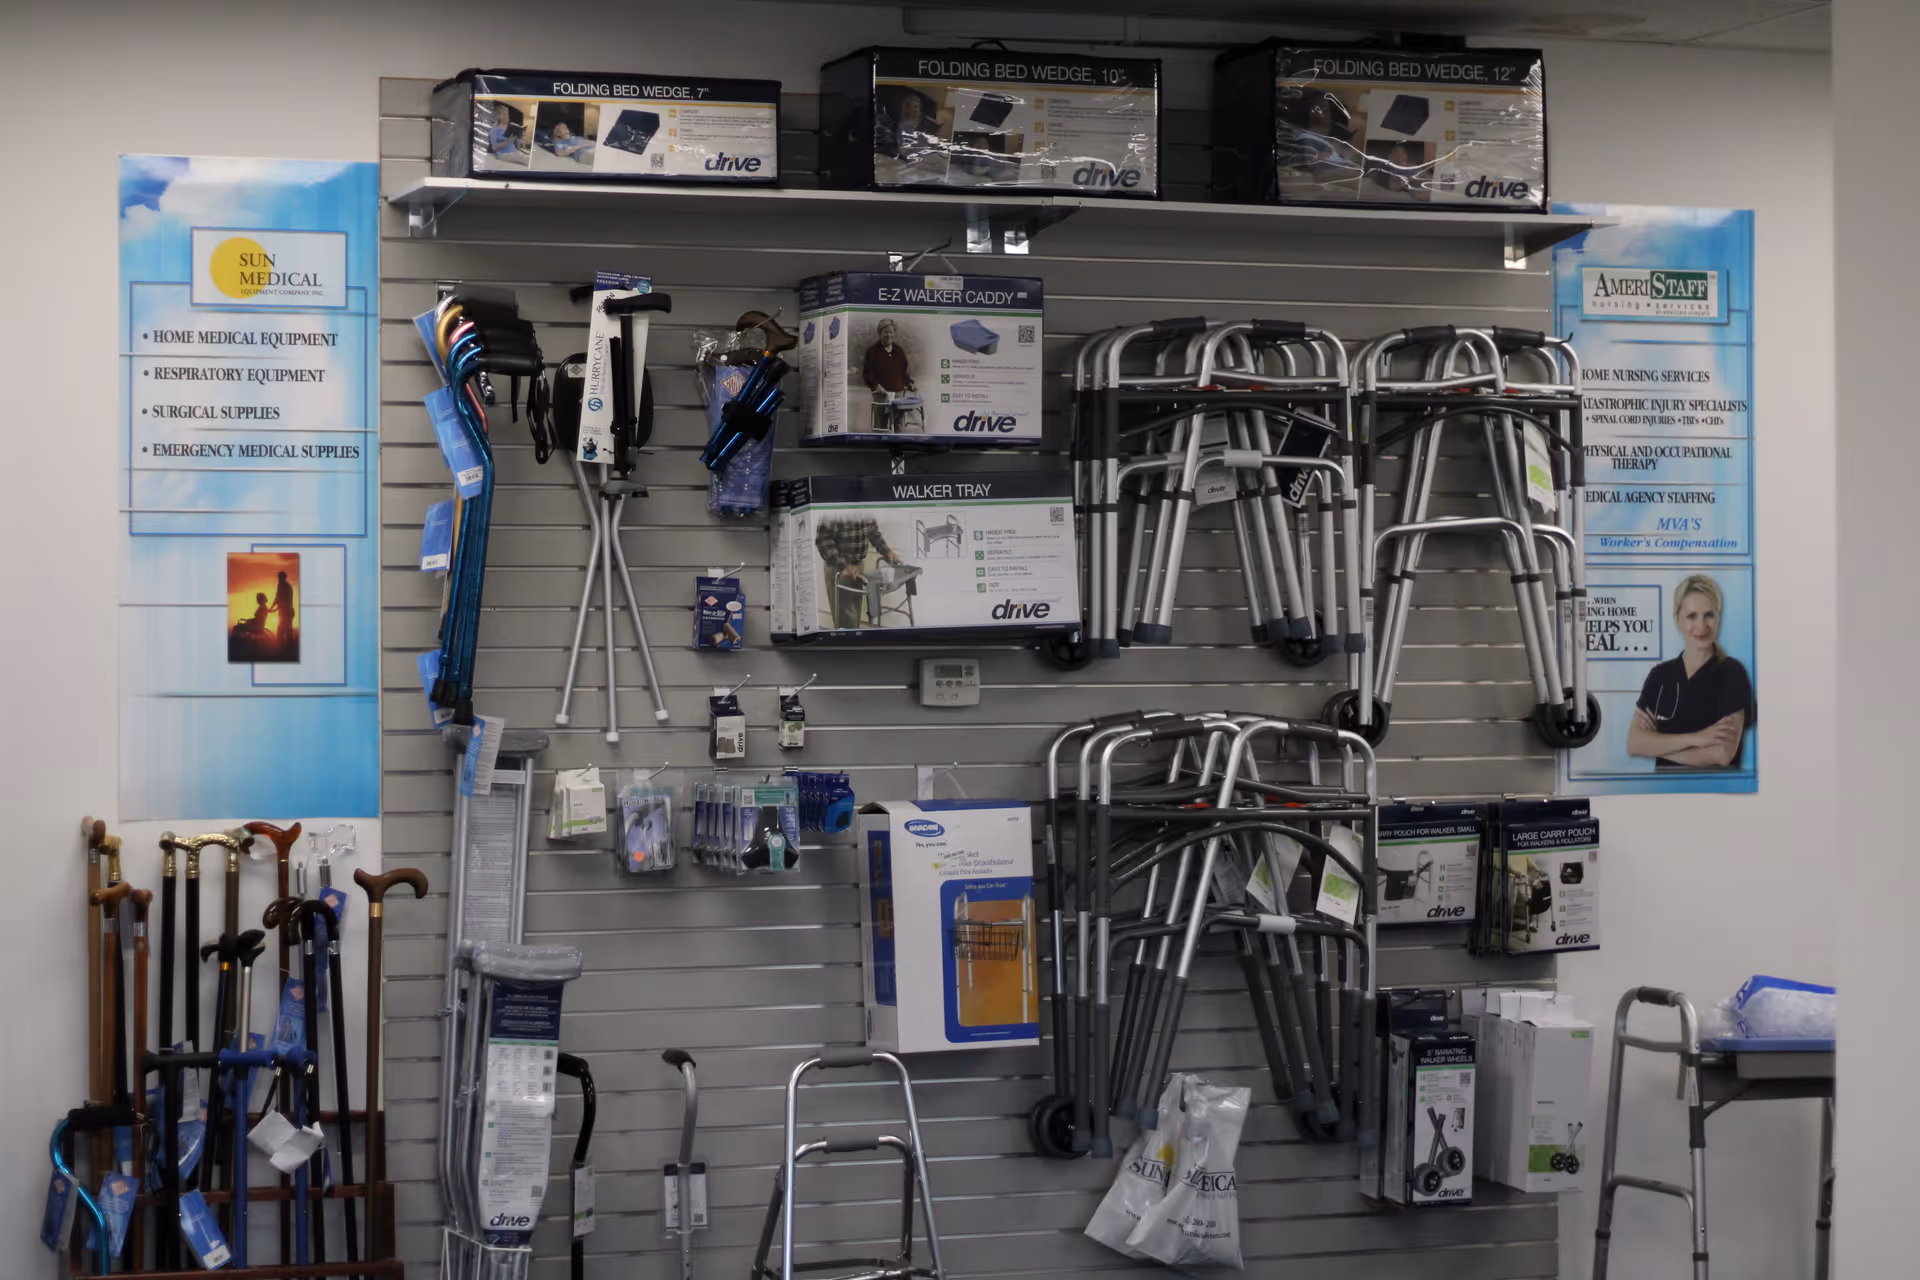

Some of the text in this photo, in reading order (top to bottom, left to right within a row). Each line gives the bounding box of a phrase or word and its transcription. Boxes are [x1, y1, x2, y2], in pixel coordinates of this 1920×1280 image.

[918, 59, 1125, 83] FOLDING BED WEDGE, 10"
[1314, 58, 1516, 82] FOLDING BED WEDGE, 12"
[553, 82, 711, 100] FOLDING BED WEDGE, 7"
[704, 152, 762, 173] drive
[1073, 162, 1142, 189] drive
[1464, 175, 1529, 199] drive
[239, 252, 276, 268] SUN
[240, 271, 323, 287] MEDICAL
[241, 288, 278, 296] EQUIPMENT
[878, 287, 1014, 305] E-Z WALKER CADDY
[1592, 300, 1710, 311] nursing services
[153, 329, 339, 349] HOME MEDICAL EQUIPMENT
[590, 330, 605, 395] HURRYCANE
[153, 367, 326, 385] RESPIRATORY EQUIPMENT
[1612, 369, 1659, 382] NURSING
[1660, 370, 1711, 383] SERVICES
[152, 405, 281, 420] SURGICAL SUPPLIES
[1650, 399, 1686, 413] INJURY
[1688, 400, 1748, 412] SPECIALISTS
[953, 410, 1017, 433] drive
[1591, 414, 1619, 424] SPINAL
[1619, 415, 1642, 424] CORD
[1642, 415, 1676, 427] INJURIES
[153, 443, 360, 460] EMERGENCY MEDICAL SUPPLIES
[1630, 446, 1653, 458] AND
[1654, 446, 1733, 459] OCCUPATIONAL
[1611, 457, 1658, 470] THERAPY
[892, 484, 992, 499] WALKER TRAY
[1207, 484, 1227, 495] drive
[1289, 469, 1309, 502] driv
[1585, 490, 1716, 505] EDICAL AGENCY STAFFING
[1655, 518, 1703, 532] MVA'S
[1599, 536, 1738, 550] Worker's Compensation
[991, 598, 1051, 620] drive
[1607, 606, 1637, 617] HOME
[1623, 620, 1654, 633] YOU
[1393, 828, 1416, 837] POUCH
[1416, 828, 1430, 836] FOR
[1457, 825, 1477, 833] SMALL
[1513, 826, 1596, 842] LARGE CARRY POUCH
[1517, 840, 1529, 848] FOR
[1529, 838, 1553, 847] WALKERS
[1427, 905, 1466, 918] drive
[1555, 932, 1591, 946] drive
[1435, 1047, 1467, 1056] BARIATRIC
[1420, 1055, 1473, 1064] WALKER WHEELS
[1438, 1187, 1464, 1198] drive
[490, 1212, 530, 1227] drive
